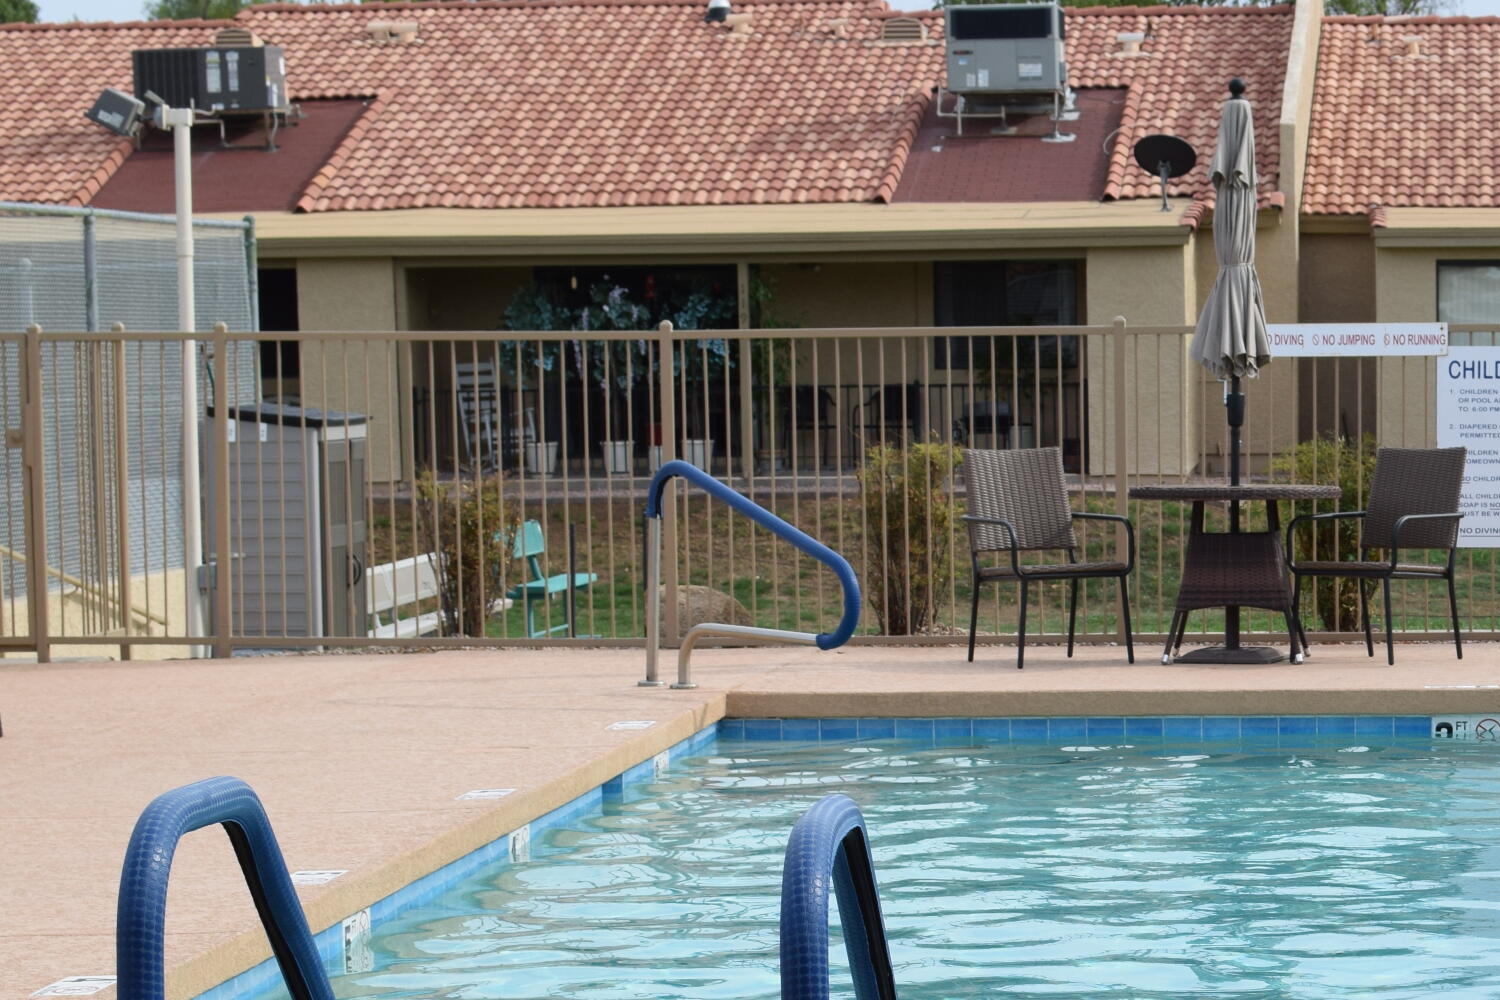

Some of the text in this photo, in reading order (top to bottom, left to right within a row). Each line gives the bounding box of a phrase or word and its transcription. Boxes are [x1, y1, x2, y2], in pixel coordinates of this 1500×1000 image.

[1274, 334, 1304, 346] DIVING
[1322, 334, 1376, 346] NO JUMPING
[1393, 334, 1446, 345] NO RUNNING
[1460, 527, 1473, 535] NO
